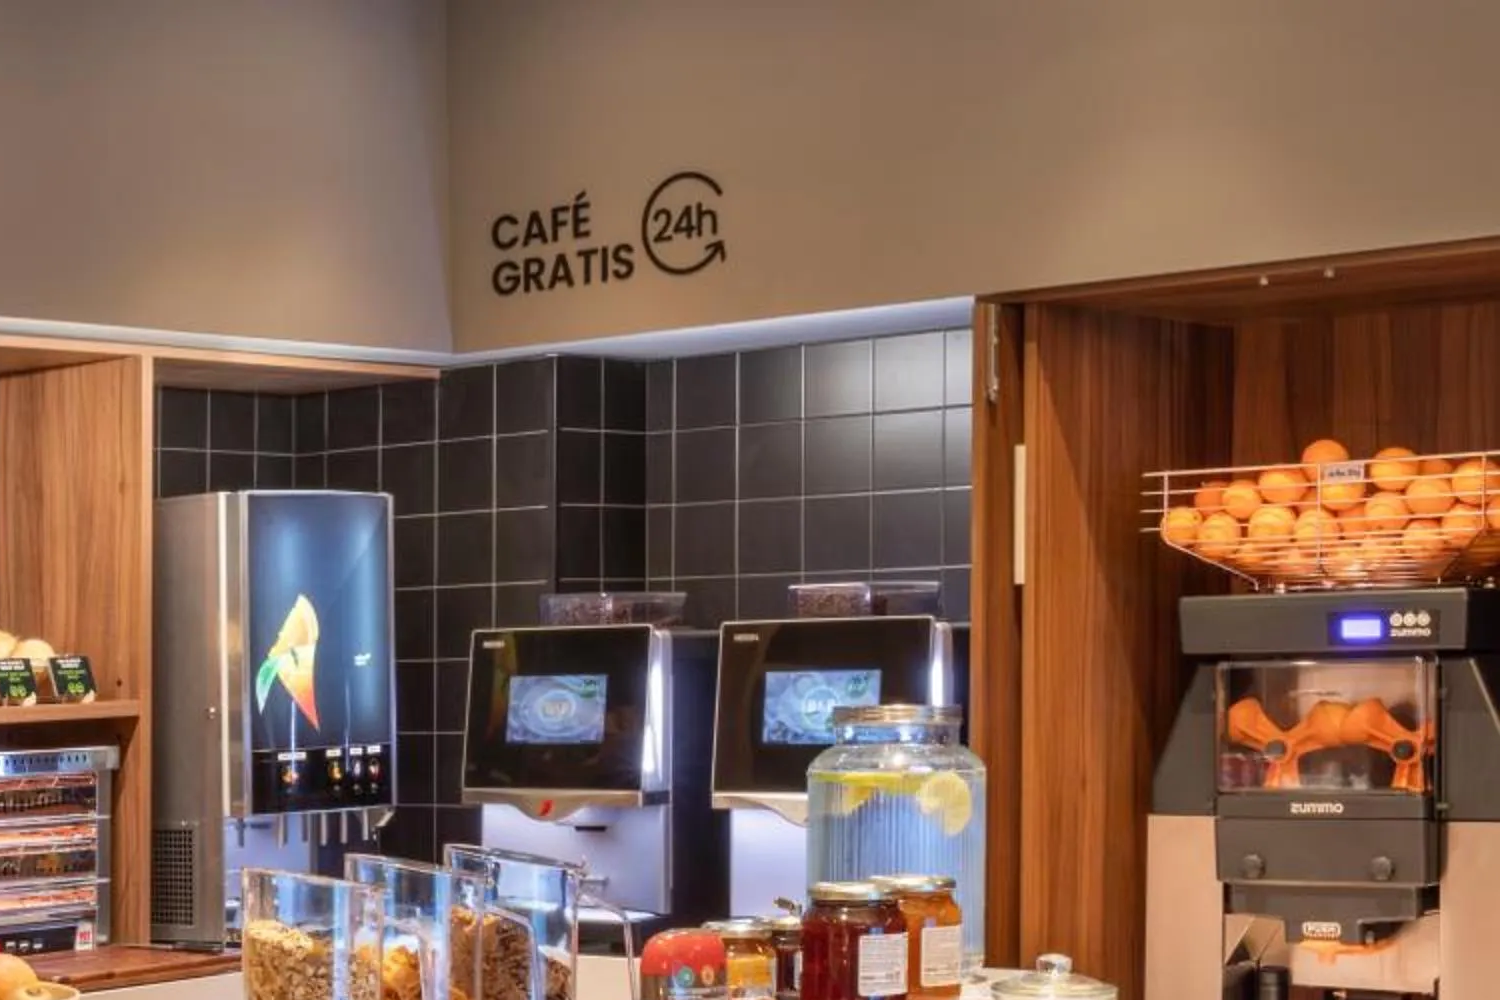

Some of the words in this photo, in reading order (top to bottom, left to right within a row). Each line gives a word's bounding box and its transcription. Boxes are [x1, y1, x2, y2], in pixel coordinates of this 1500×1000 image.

[491, 190, 591, 250] CAFÉ
[652, 201, 719, 244] 24h
[491, 243, 635, 296] GRATIS
[1290, 802, 1345, 814] zummo
